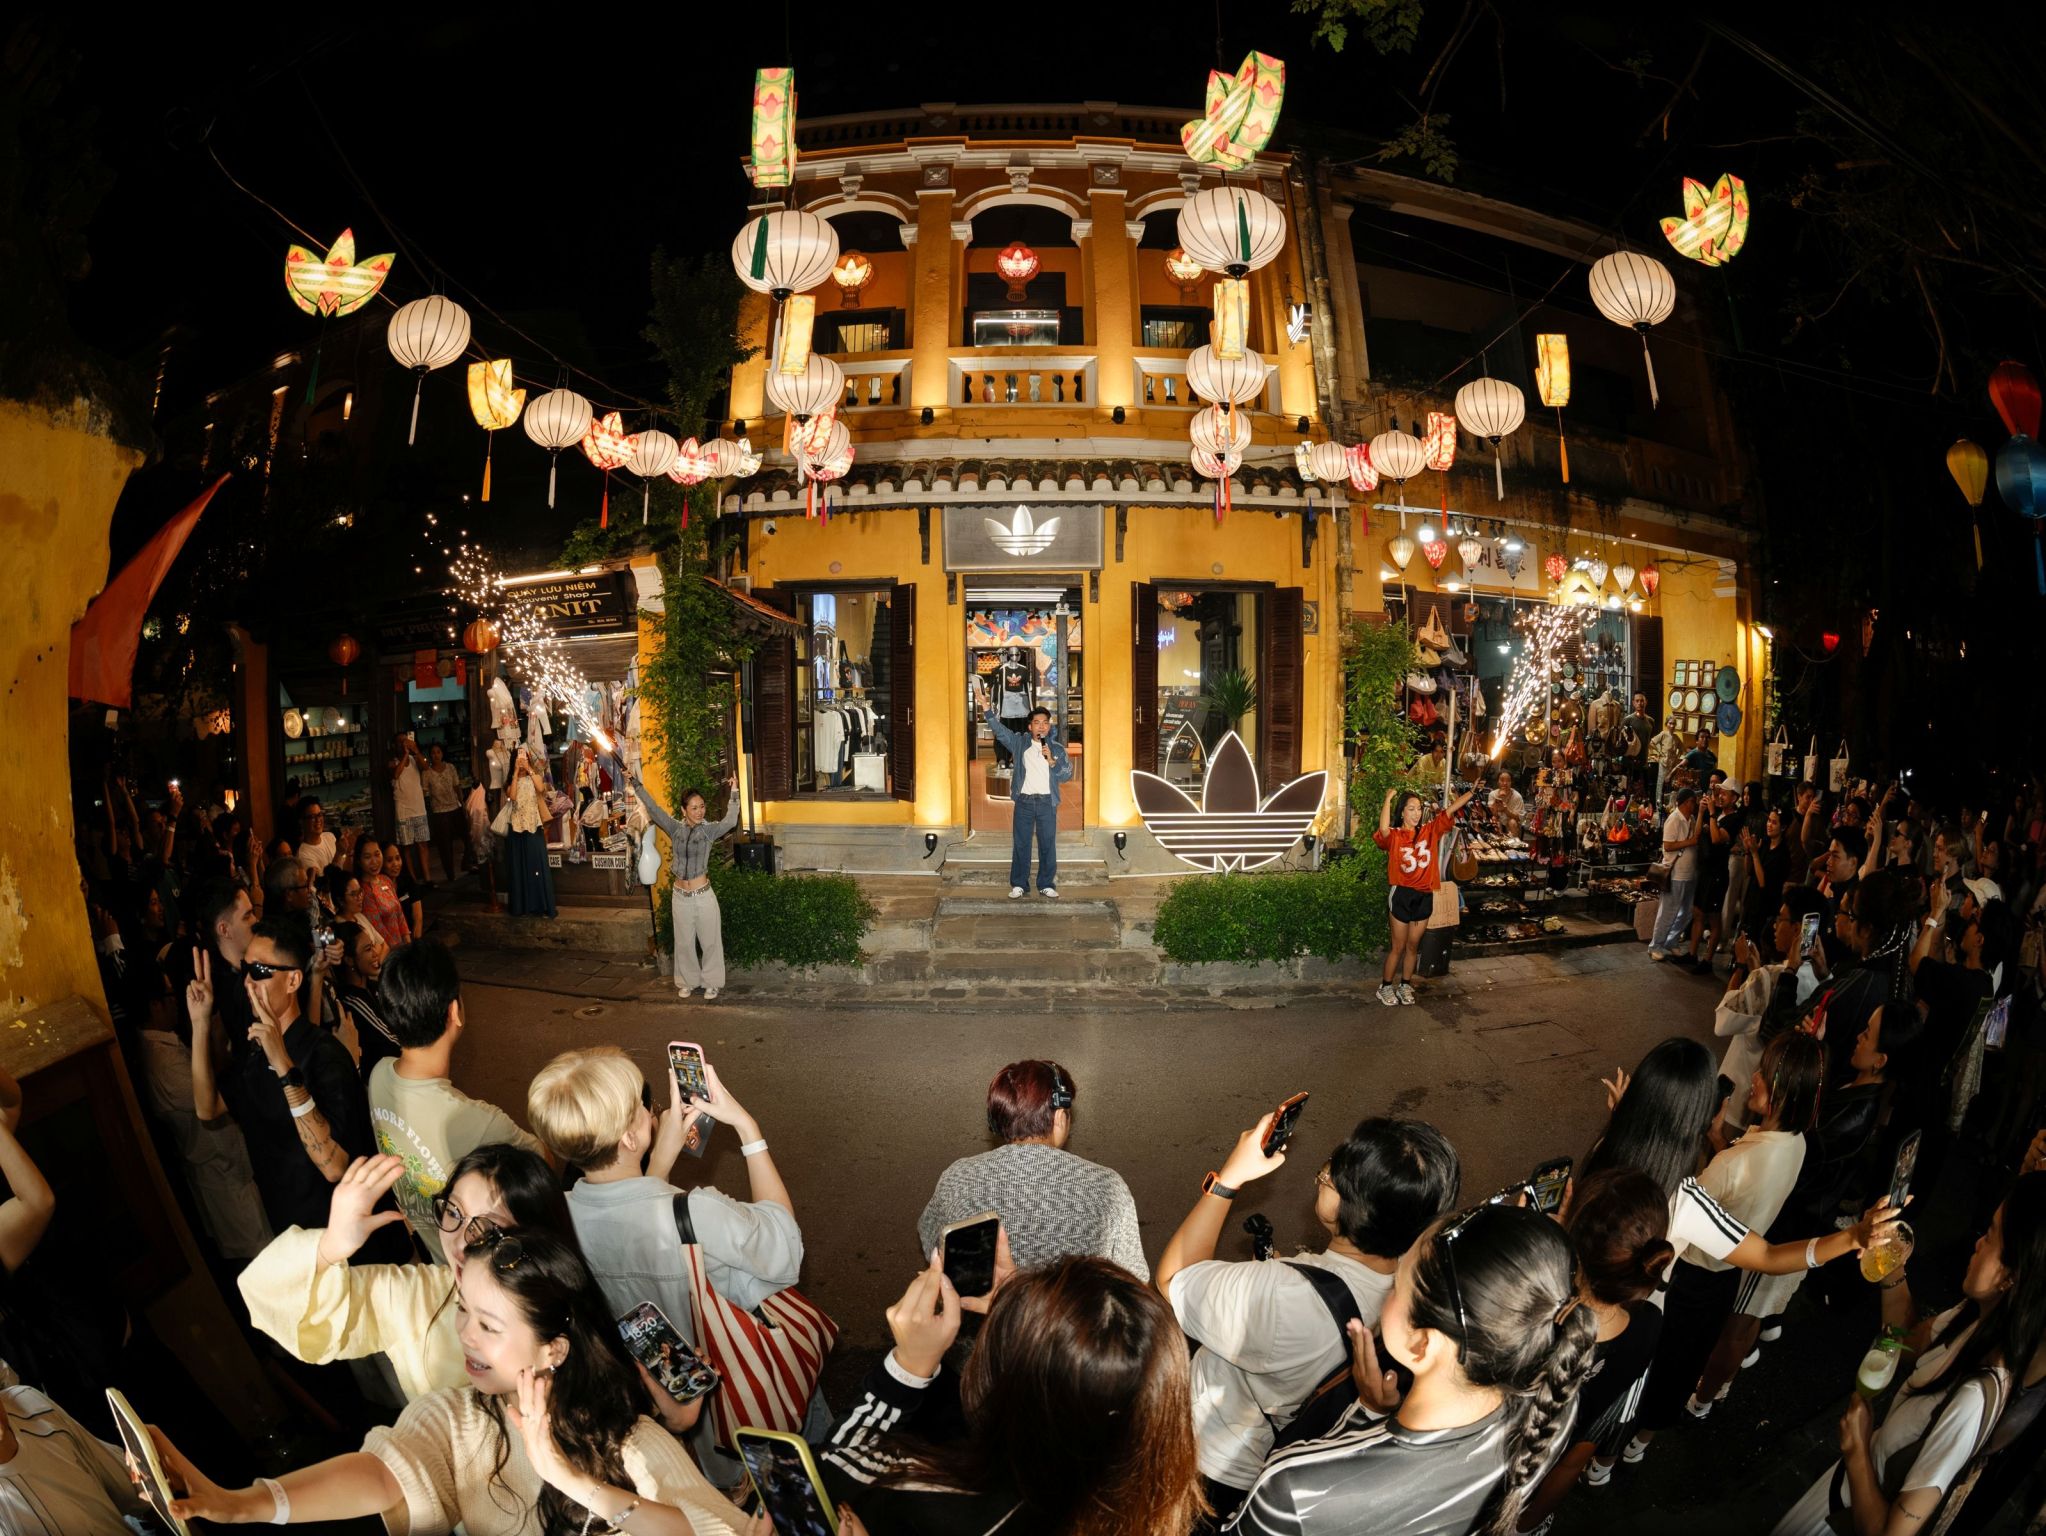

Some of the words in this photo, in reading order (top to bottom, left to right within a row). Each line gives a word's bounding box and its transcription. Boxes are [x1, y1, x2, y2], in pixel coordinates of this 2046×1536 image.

[541, 585, 562, 594] LƯU
[566, 582, 597, 591] NIỆM
[517, 595, 559, 605] Souvenir
[563, 592, 590, 600] Shop
[1400, 840, 1431, 873] 33
[374, 1107, 405, 1131] MORE
